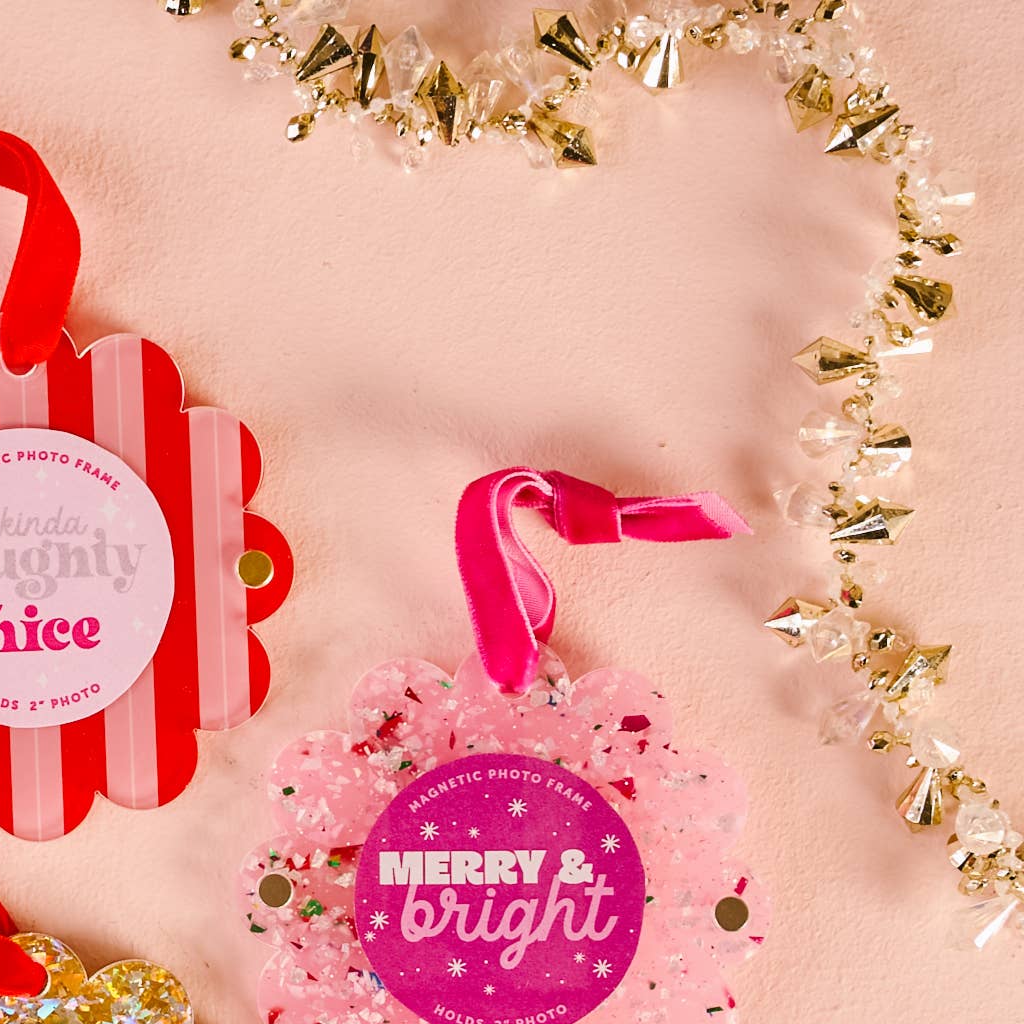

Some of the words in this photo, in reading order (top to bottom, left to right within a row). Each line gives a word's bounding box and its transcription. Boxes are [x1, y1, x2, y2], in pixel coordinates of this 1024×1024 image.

[17, 451, 70, 464] PHOTO
[75, 459, 120, 491] FRAME
[51, 683, 100, 708] PHOTO
[408, 771, 482, 813] MAGNETIC
[488, 769, 541, 784] PHOTO
[546, 779, 593, 811] FRAME
[378, 850, 547, 886] MERRY
[559, 849, 594, 884] &
[401, 874, 618, 970] bright
